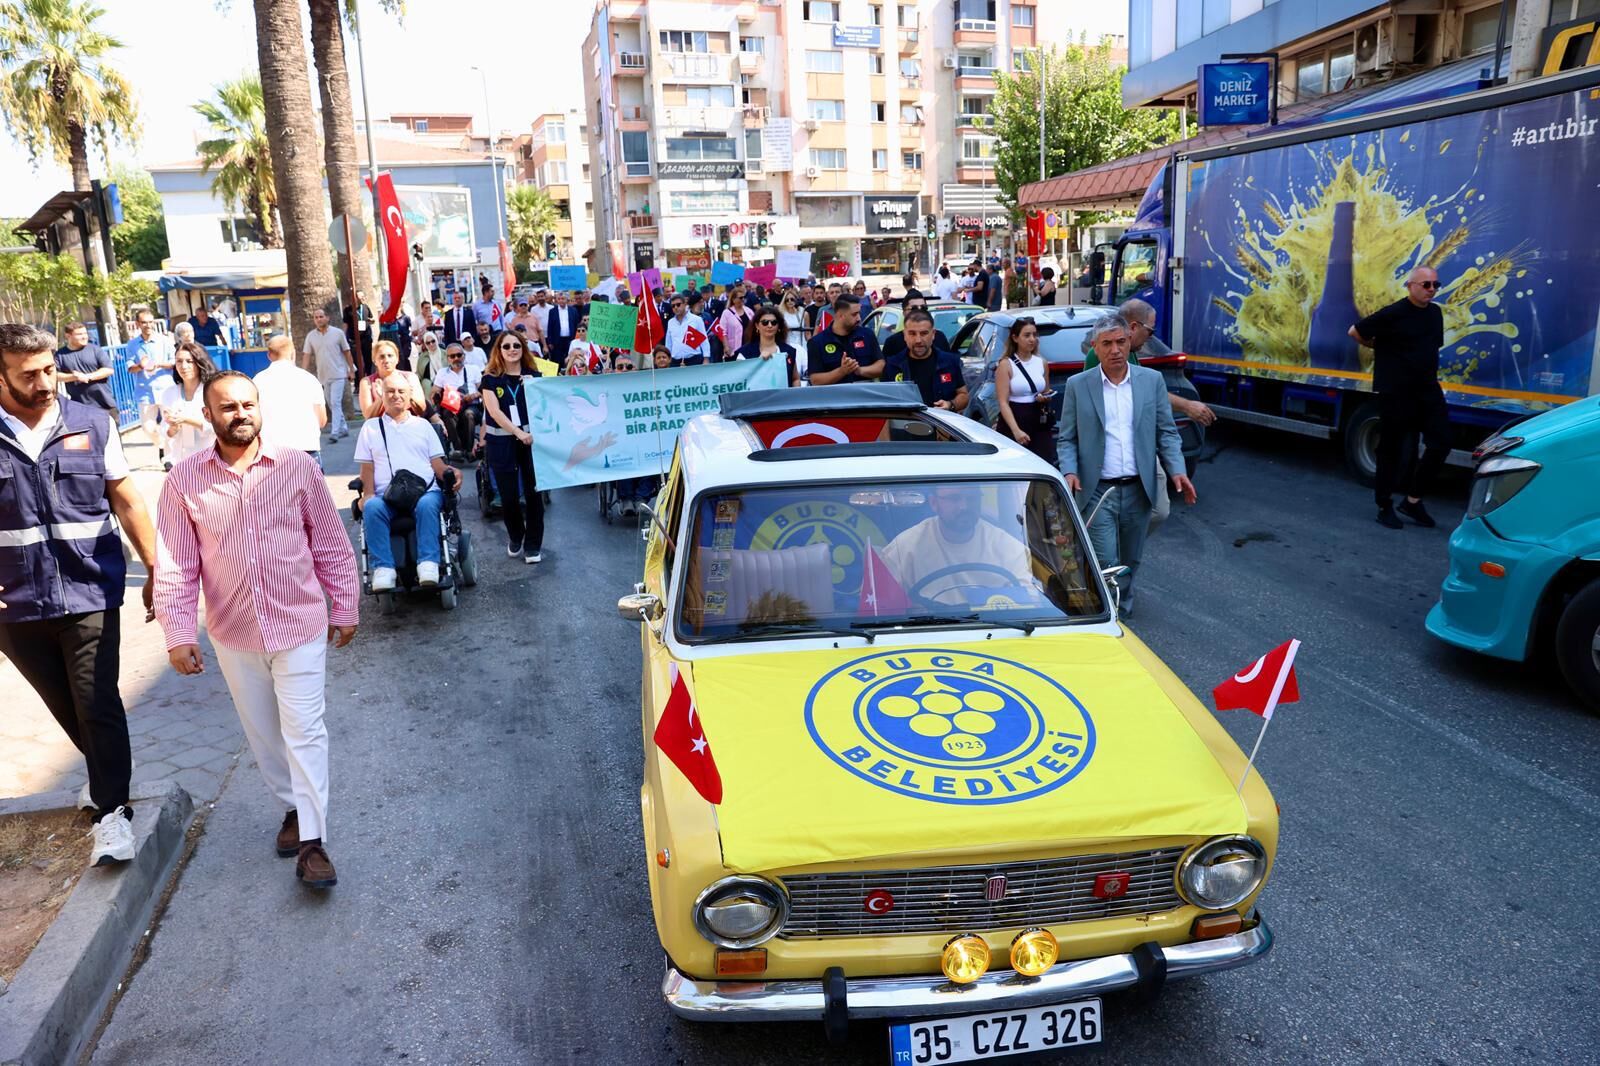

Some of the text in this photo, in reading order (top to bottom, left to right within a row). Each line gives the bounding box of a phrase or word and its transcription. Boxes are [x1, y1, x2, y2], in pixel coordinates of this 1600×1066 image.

[1220, 78, 1252, 92] DENİZ
[1214, 94, 1258, 107] MARKET
[1511, 115, 1598, 147] #artıbir
[729, 222, 776, 236] OPTK
[880, 217, 906, 230] optik
[985, 215, 1007, 228] optik
[622, 390, 662, 404] VARIZ
[664, 382, 709, 401] ÇÜNKÜ
[624, 399, 719, 420] BARIŞ VE EMPA
[626, 416, 691, 435] BİR ARAD
[772, 503, 859, 530] BUCA
[848, 656, 995, 683] BUCA
[947, 739, 984, 751] 1923
[841, 730, 1083, 796] BELEDİYESİ
[988, 879, 1005, 899] FIAT
[914, 1006, 1097, 1063] 35 CZZ 326
[895, 1051, 910, 1062] TR
